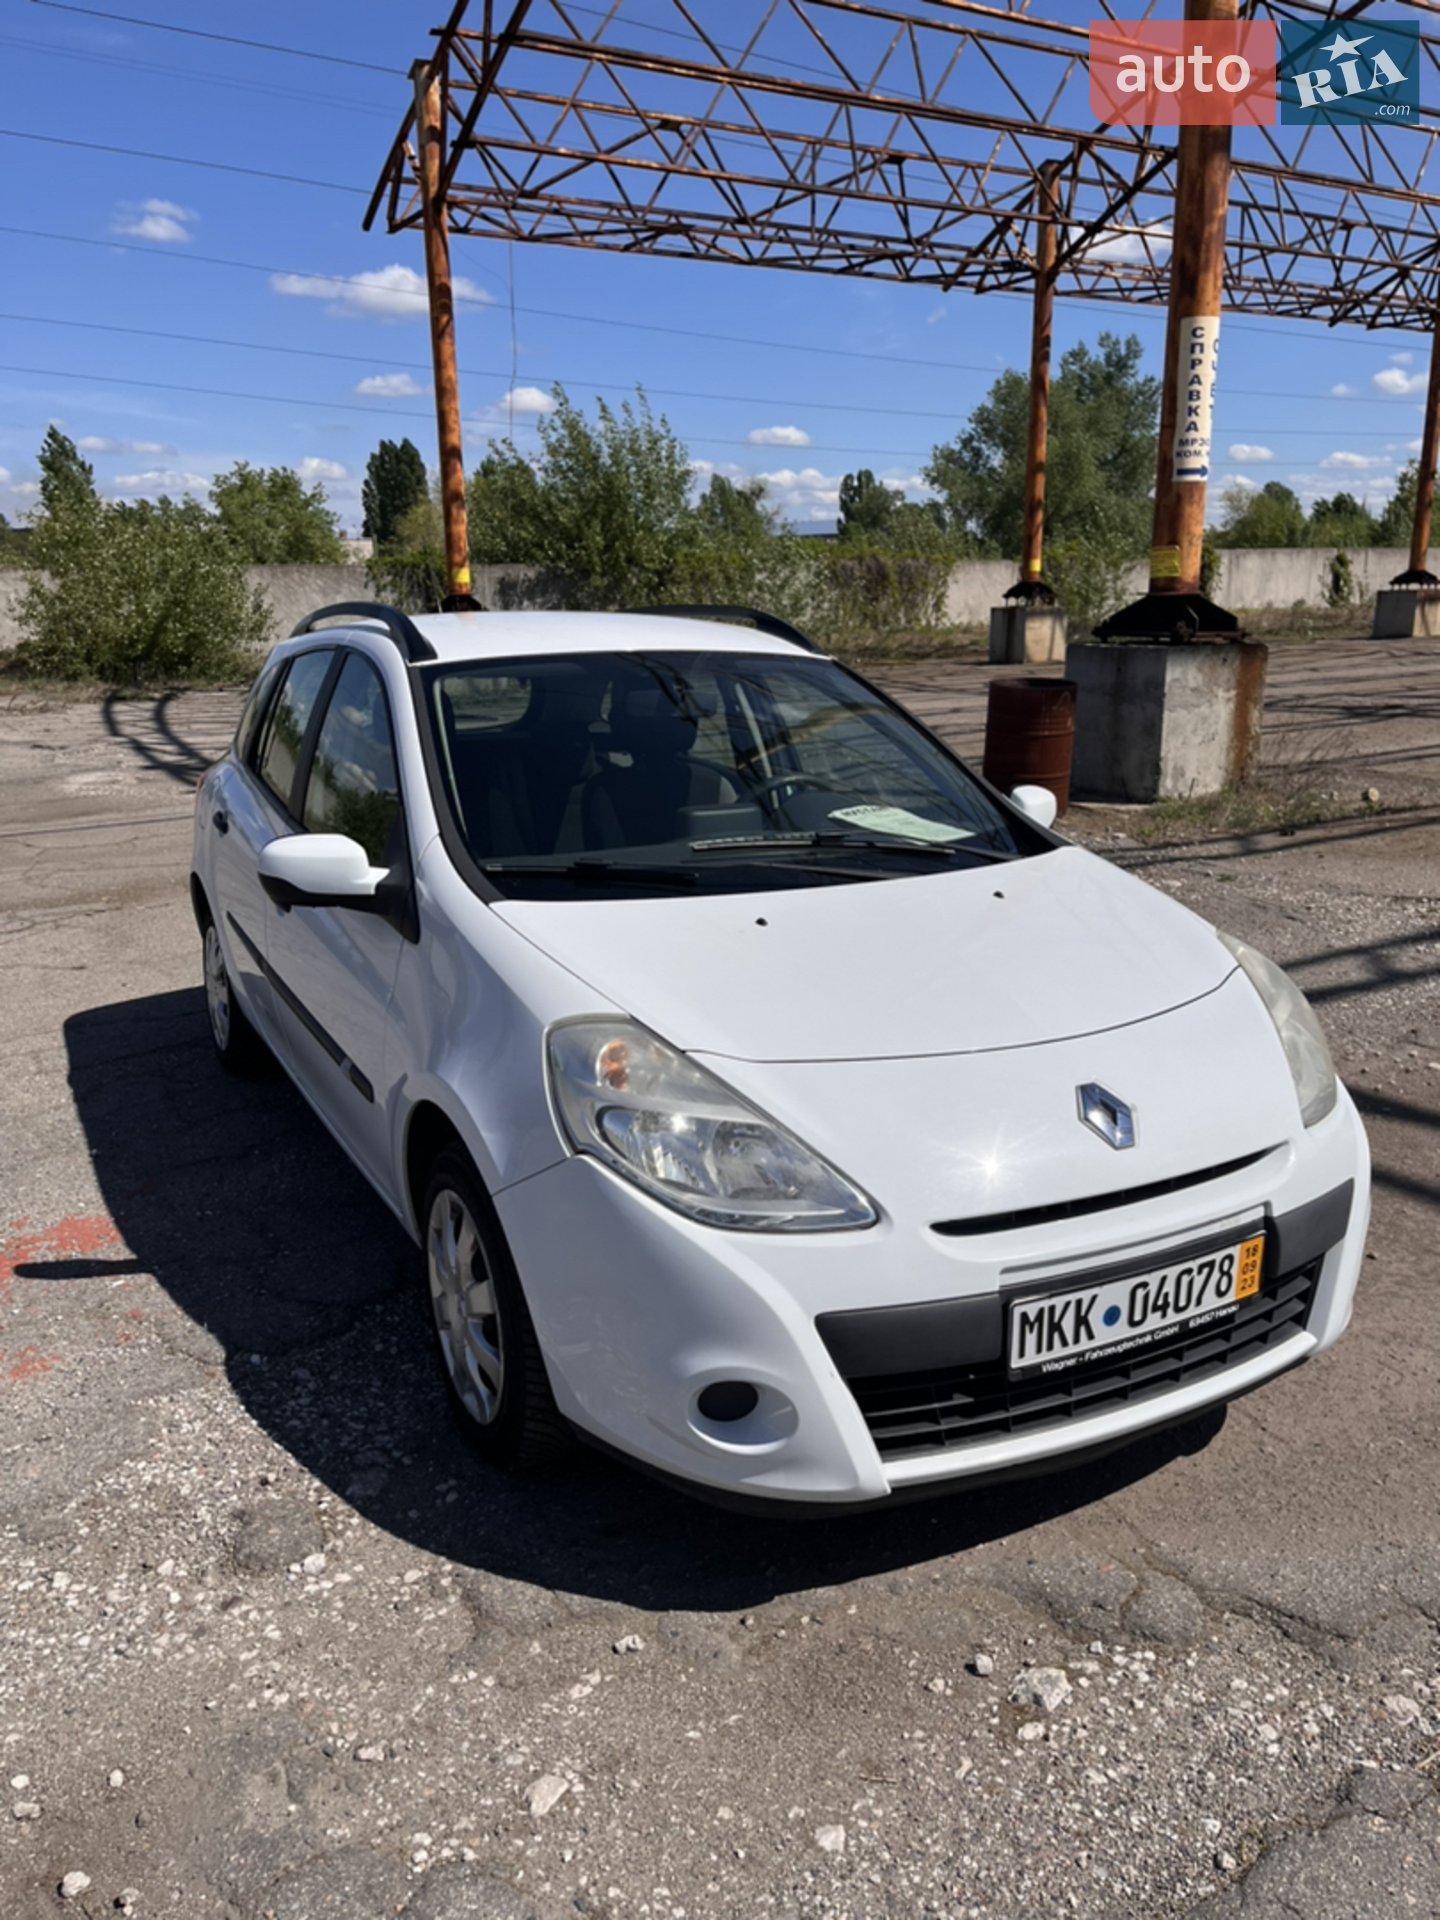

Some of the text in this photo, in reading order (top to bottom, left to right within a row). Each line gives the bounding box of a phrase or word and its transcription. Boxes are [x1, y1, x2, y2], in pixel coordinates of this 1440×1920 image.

[1185, 326, 1205, 432] СПРАВКА
[1018, 1253, 1235, 1359] MKK 04078
[1041, 1357, 1078, 1373] Wagner
[1084, 1333, 1153, 1361] Fahrzeugtechnik
[1153, 1324, 1179, 1339] GmbH
[1215, 1303, 1240, 1318] Hanau
